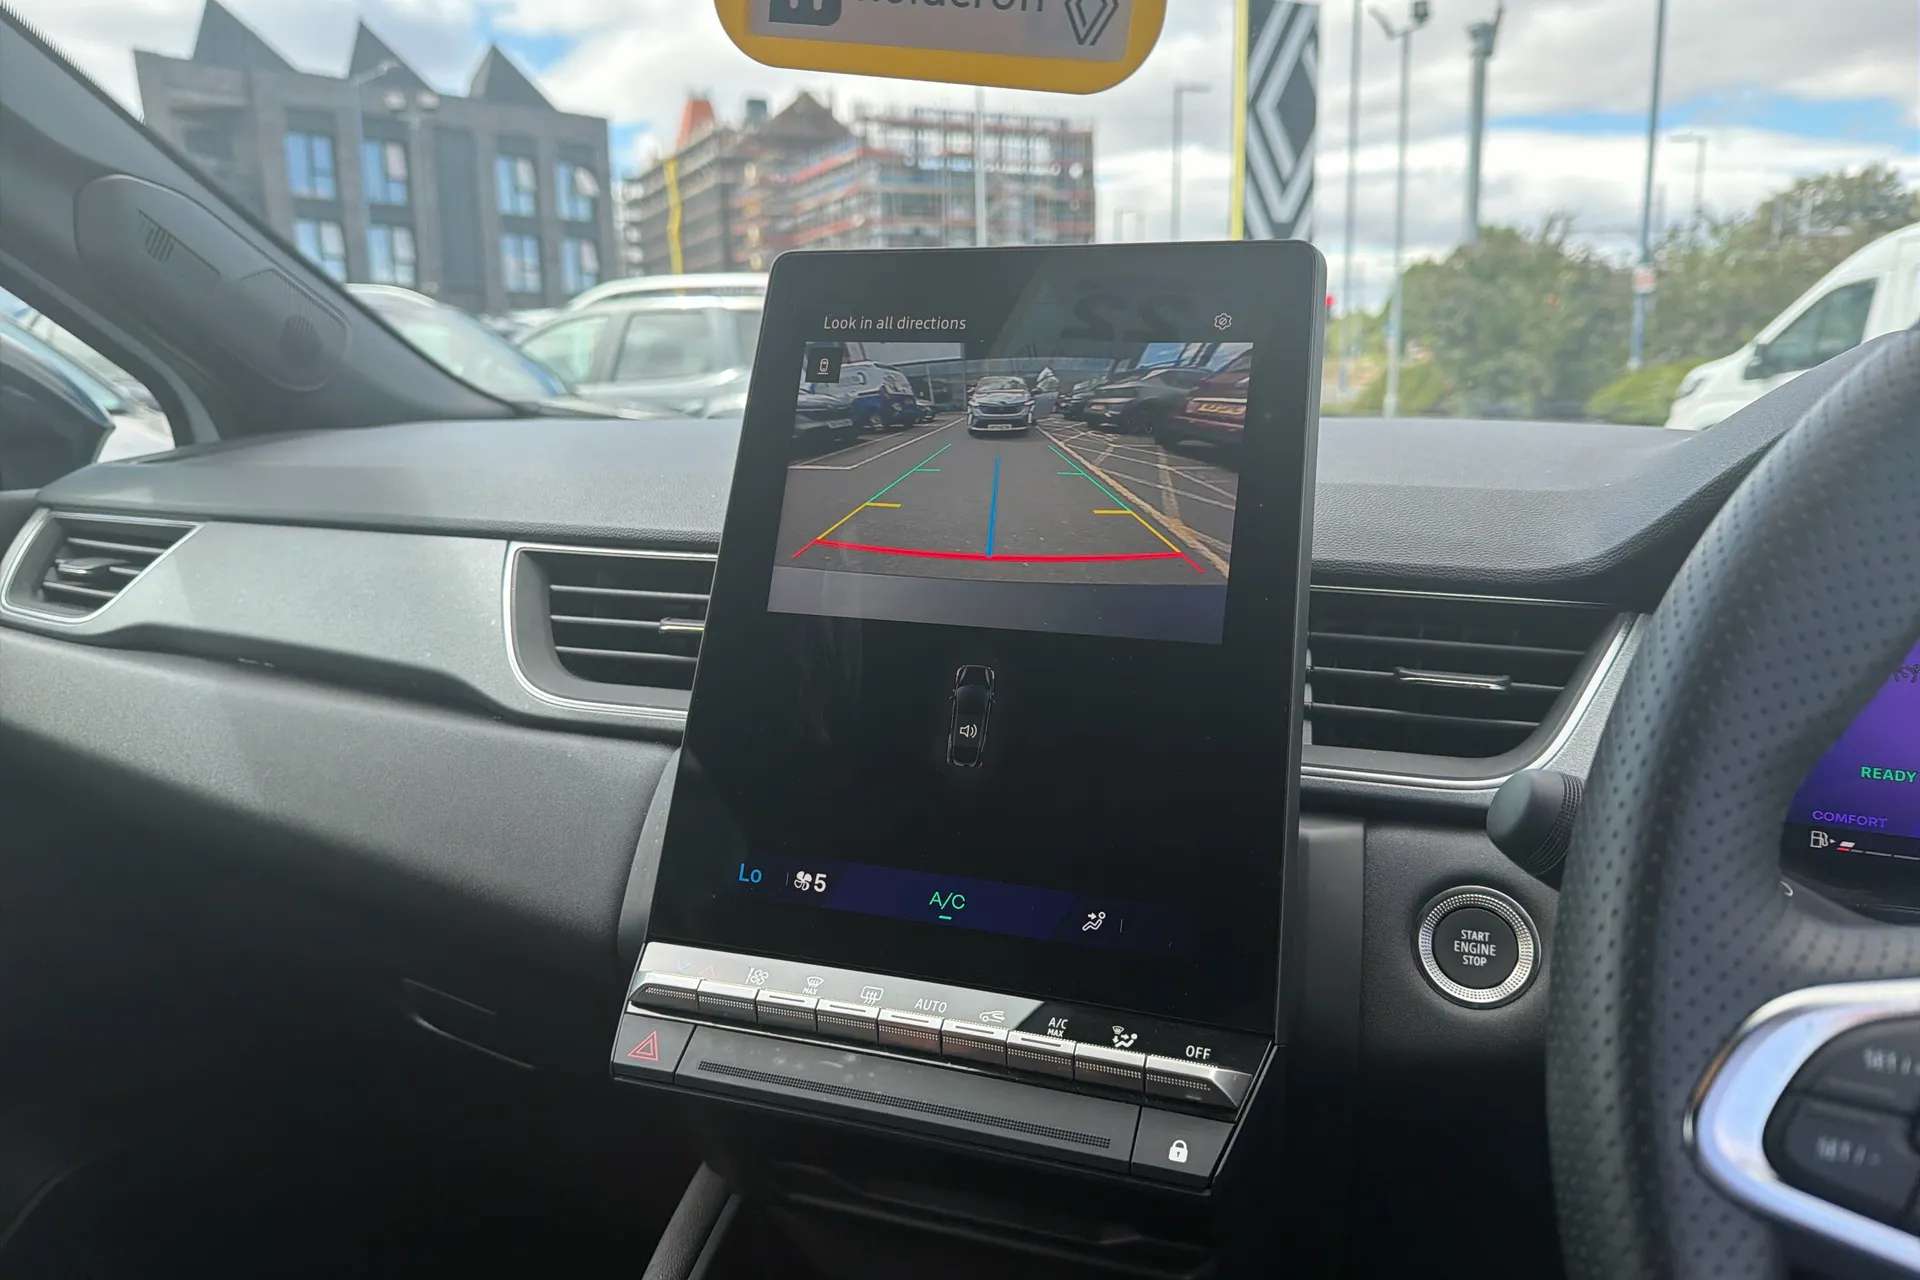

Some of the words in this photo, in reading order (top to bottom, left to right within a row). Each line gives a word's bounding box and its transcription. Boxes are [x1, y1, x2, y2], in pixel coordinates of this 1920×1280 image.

[824, 316, 857, 330] Look
[860, 316, 873, 330] in
[876, 316, 894, 330] all
[897, 316, 967, 330] directions
[1860, 766, 1917, 783] READY
[1812, 810, 1888, 828] COMFORT
[737, 863, 762, 884] Lo
[813, 873, 828, 893] 5
[929, 891, 966, 910] A/C
[1461, 929, 1490, 941] START
[1454, 940, 1496, 956] ENGINE
[1462, 955, 1487, 967] STOP
[802, 987, 818, 995] MAX
[914, 998, 948, 1013] AUTO
[1048, 1016, 1069, 1030] A/C
[1047, 1028, 1065, 1038] MAX
[1185, 1044, 1212, 1060] OFF
